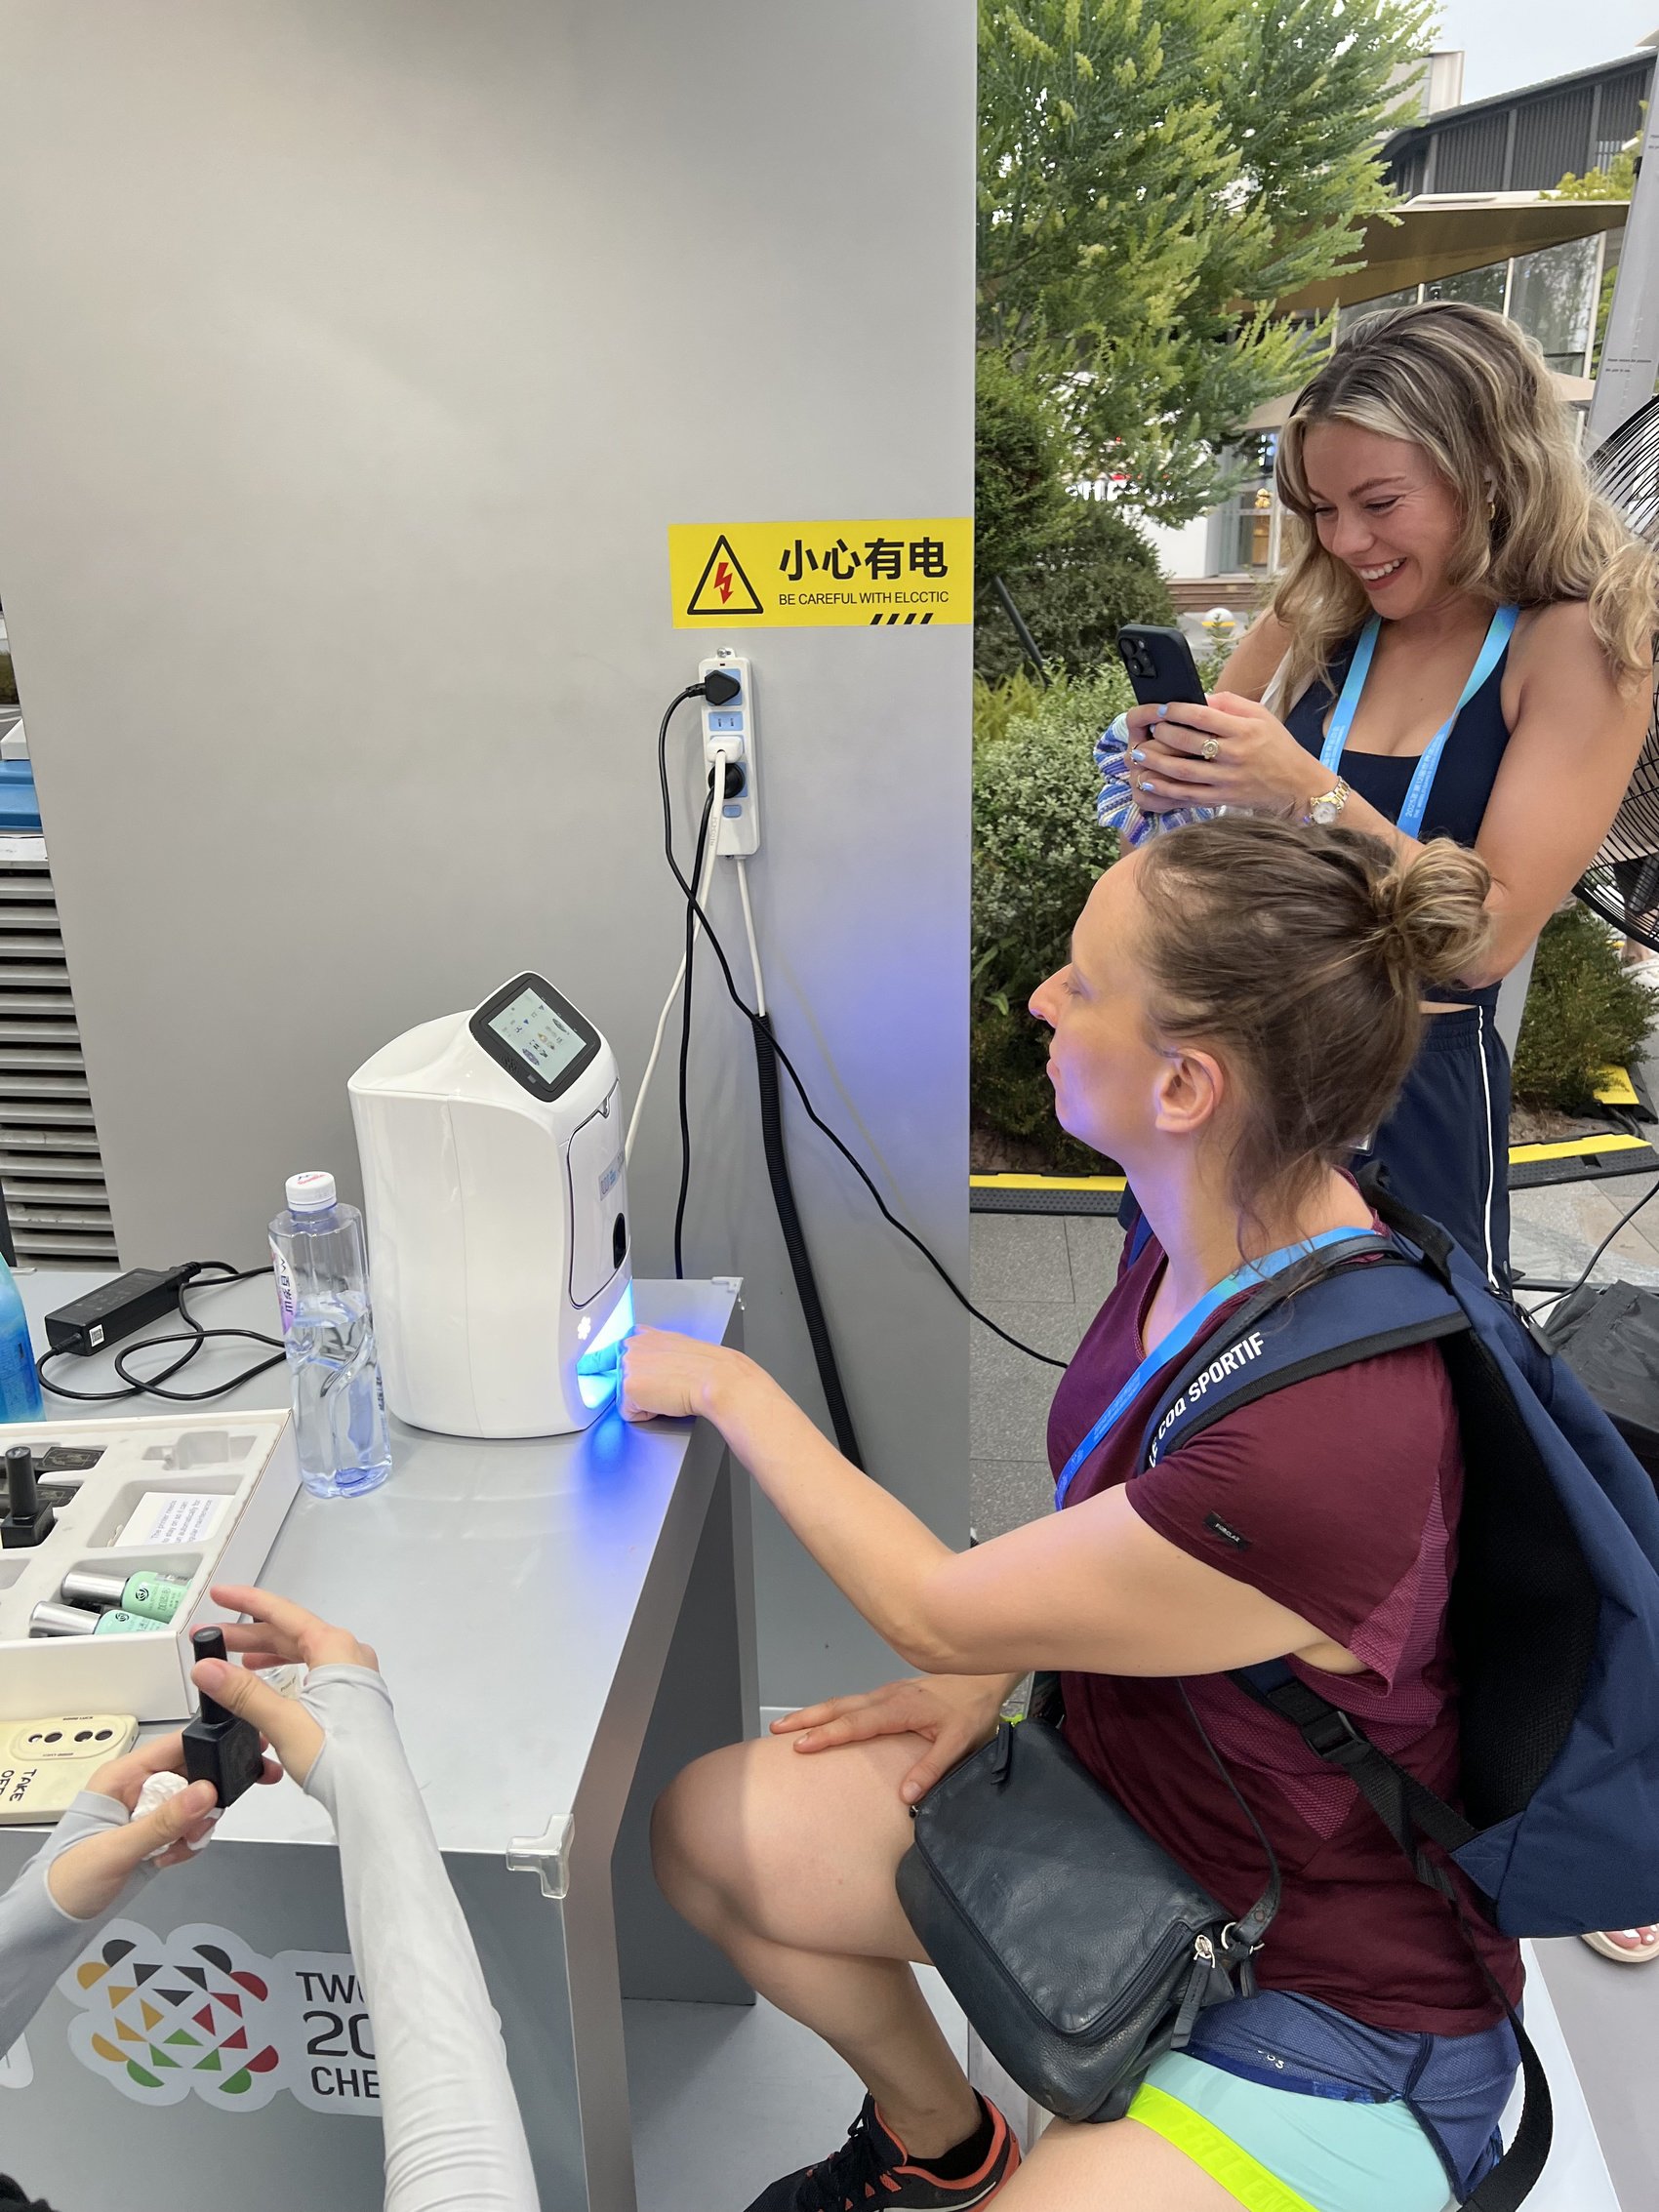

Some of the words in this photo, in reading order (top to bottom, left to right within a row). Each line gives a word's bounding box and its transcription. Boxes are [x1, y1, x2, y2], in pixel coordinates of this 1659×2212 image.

[779, 537, 949, 582] 小心有电
[779, 593, 795, 606] BE
[798, 592, 857, 605] CAREFUL
[859, 591, 892, 604] WITH
[895, 590, 950, 604] ELCCTIC
[1150, 1437, 1158, 1468] LE
[1158, 1397, 1187, 1439] COQ
[1188, 1331, 1265, 1402] SPORTIF
[9, 1768, 37, 1801] TAKE
[295, 1971, 365, 2003] TW
